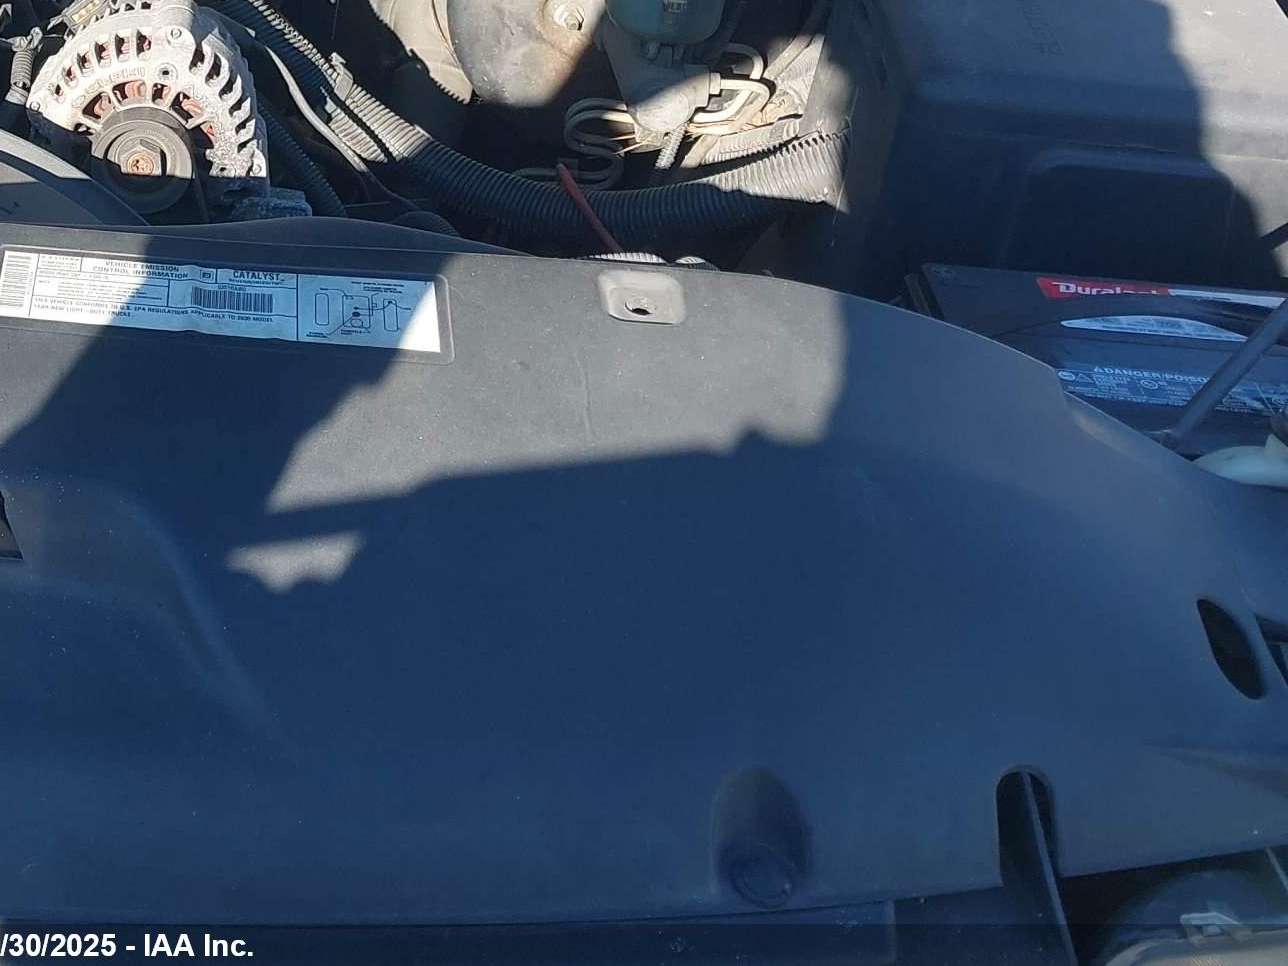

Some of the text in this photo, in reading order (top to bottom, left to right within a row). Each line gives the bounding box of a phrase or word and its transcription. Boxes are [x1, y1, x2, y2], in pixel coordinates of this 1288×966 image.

[92, 265, 130, 275] CONTROL
[132, 268, 189, 279] INFORMATION
[105, 260, 180, 273] VEHICLE EMISSION
[233, 270, 281, 281] CATALYST
[147, 306, 189, 316] REGULATIONS
[252, 315, 274, 324] MODEL
